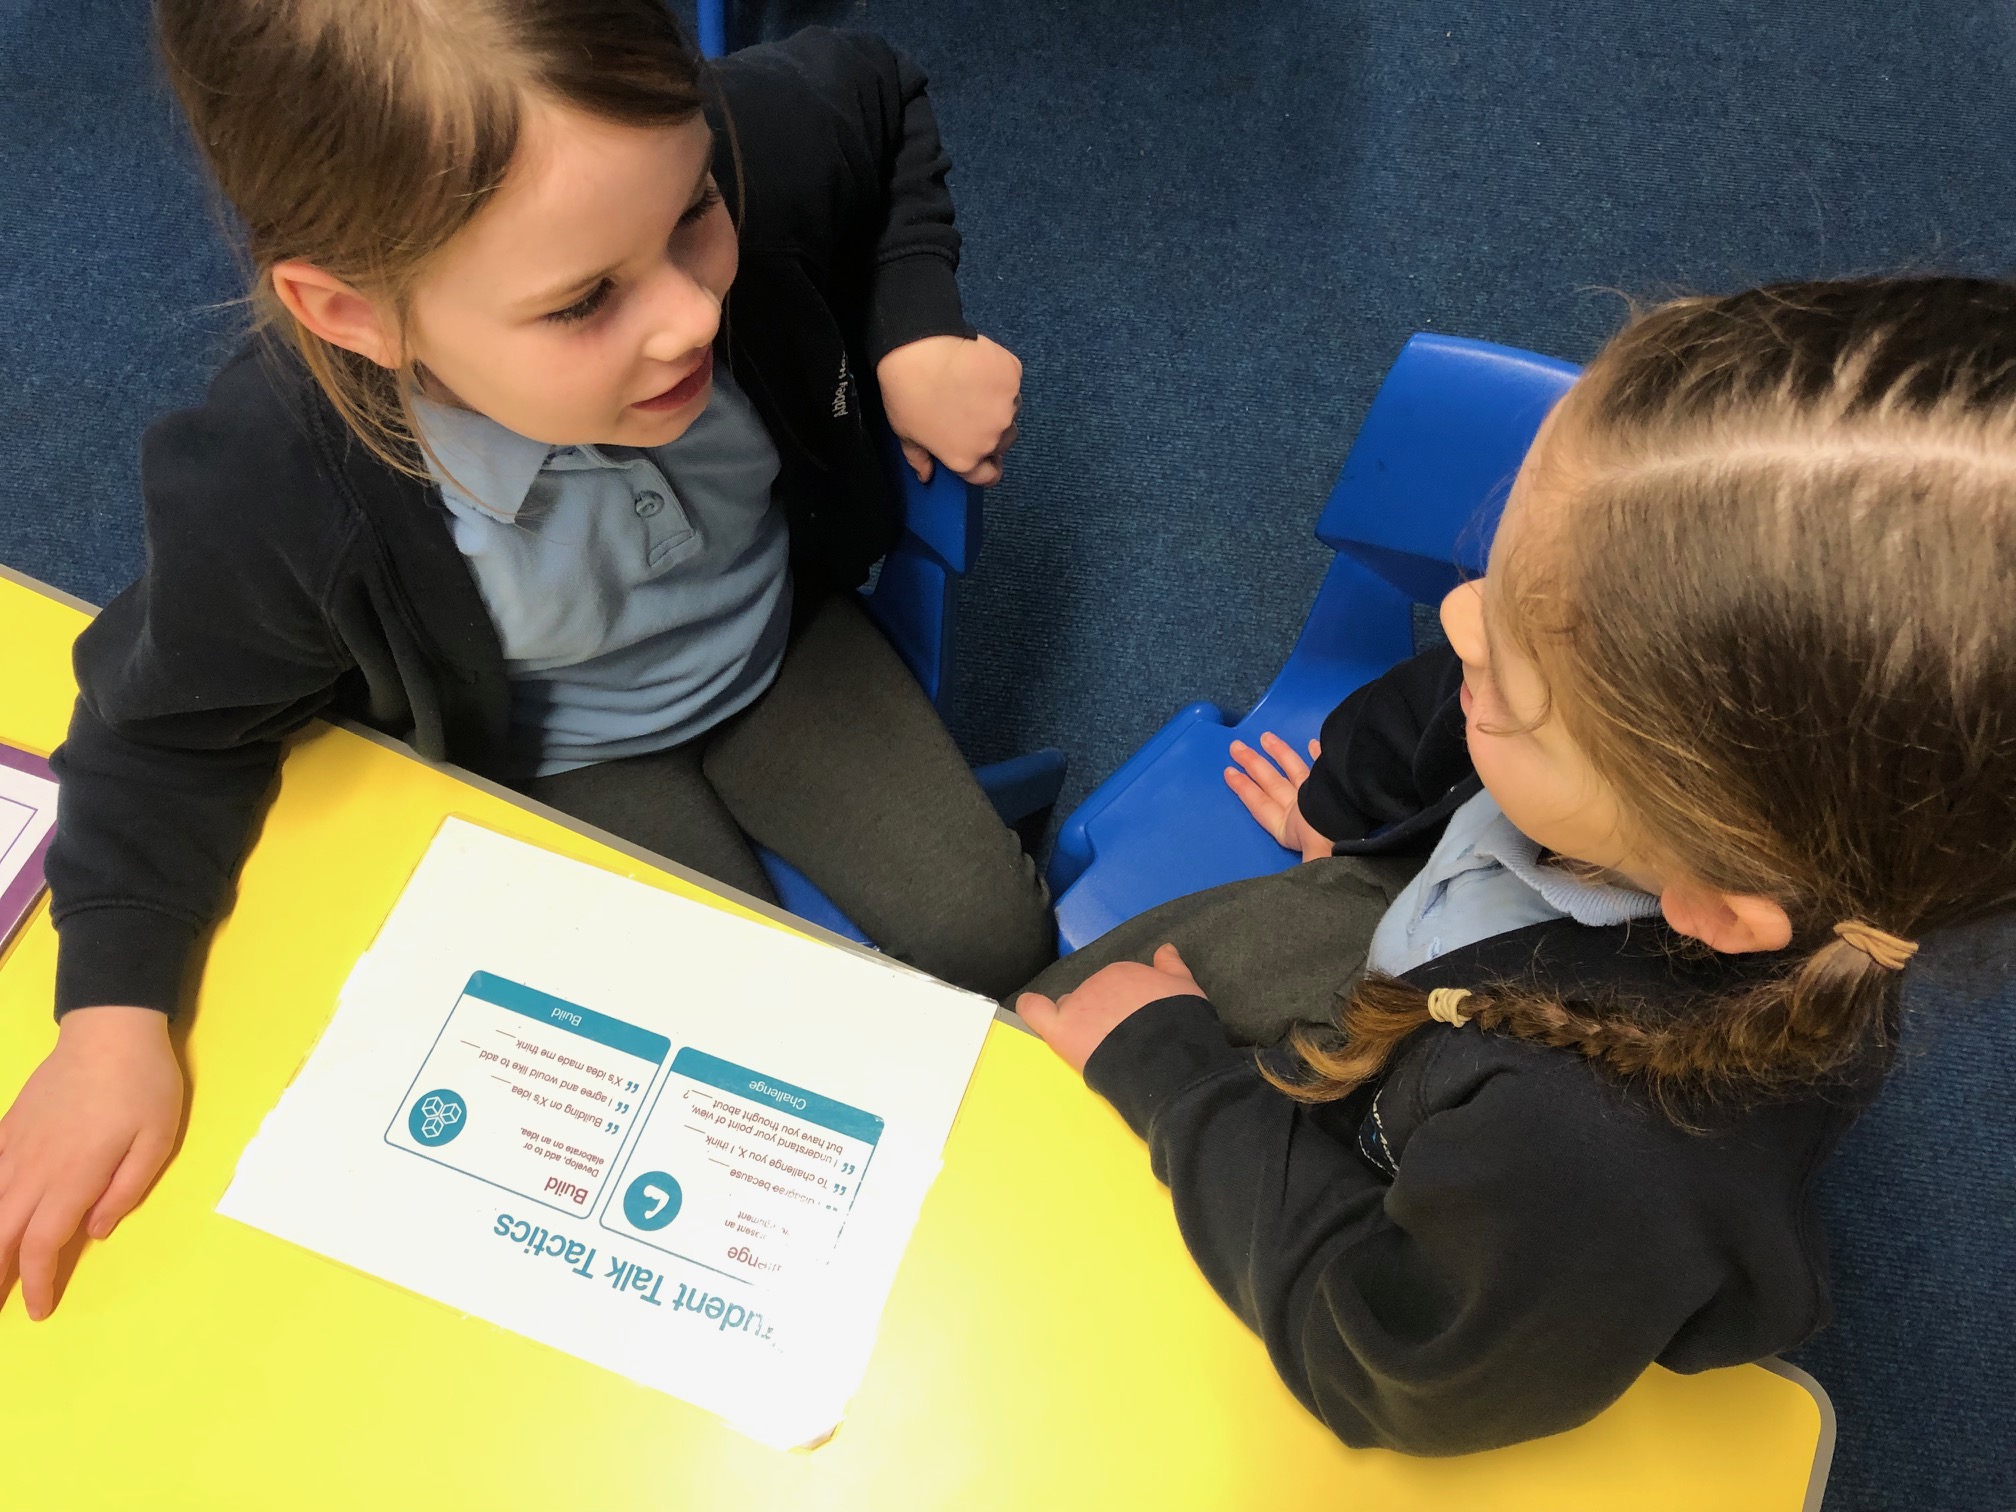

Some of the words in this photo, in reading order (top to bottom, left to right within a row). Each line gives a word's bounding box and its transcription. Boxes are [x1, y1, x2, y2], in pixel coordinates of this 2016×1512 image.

[551, 1008, 581, 1025] Build
[515, 1039, 538, 1055] think
[540, 1049, 556, 1059] me
[478, 1050, 499, 1061] add
[499, 1057, 510, 1067] to
[557, 1055, 584, 1069] made
[511, 1061, 528, 1074] like
[585, 1065, 606, 1080] idea
[528, 1068, 558, 1084] would
[511, 1085, 532, 1100] idea
[558, 1080, 578, 1091] and
[580, 1087, 607, 1102] agree
[749, 1081, 806, 1109] Challenge
[549, 1100, 562, 1110] on
[606, 1097, 613, 1107] I
[712, 1099, 741, 1115] about
[563, 1103, 602, 1127] Building
[692, 1104, 713, 1119] view,
[714, 1115, 726, 1124] of
[727, 1119, 753, 1133] point
[741, 1110, 779, 1131] thought
[520, 1127, 539, 1141] idea.
[753, 1129, 777, 1142] your
[780, 1125, 800, 1137] you
[522, 1142, 533, 1150] or
[540, 1135, 551, 1144] an
[552, 1140, 564, 1149] on
[705, 1135, 729, 1150] think
[801, 1132, 825, 1148] have
[534, 1146, 543, 1155] to
[565, 1145, 604, 1164] elaborate
[729, 1144, 735, 1154] I
[738, 1146, 747, 1158] X,
[776, 1136, 832, 1162] understand
[825, 1141, 843, 1154] but
[543, 1149, 561, 1161] add
[748, 1151, 768, 1163] you
[563, 1156, 599, 1177] Develop,
[768, 1159, 815, 1181] challenge
[729, 1168, 771, 1190] because
[817, 1177, 827, 1189] To
[544, 1176, 588, 1204] Build
[724, 1219, 735, 1228] an
[493, 1213, 596, 1279] Tactics
[604, 1256, 663, 1306] Talk
[672, 1283, 773, 1339] udent
